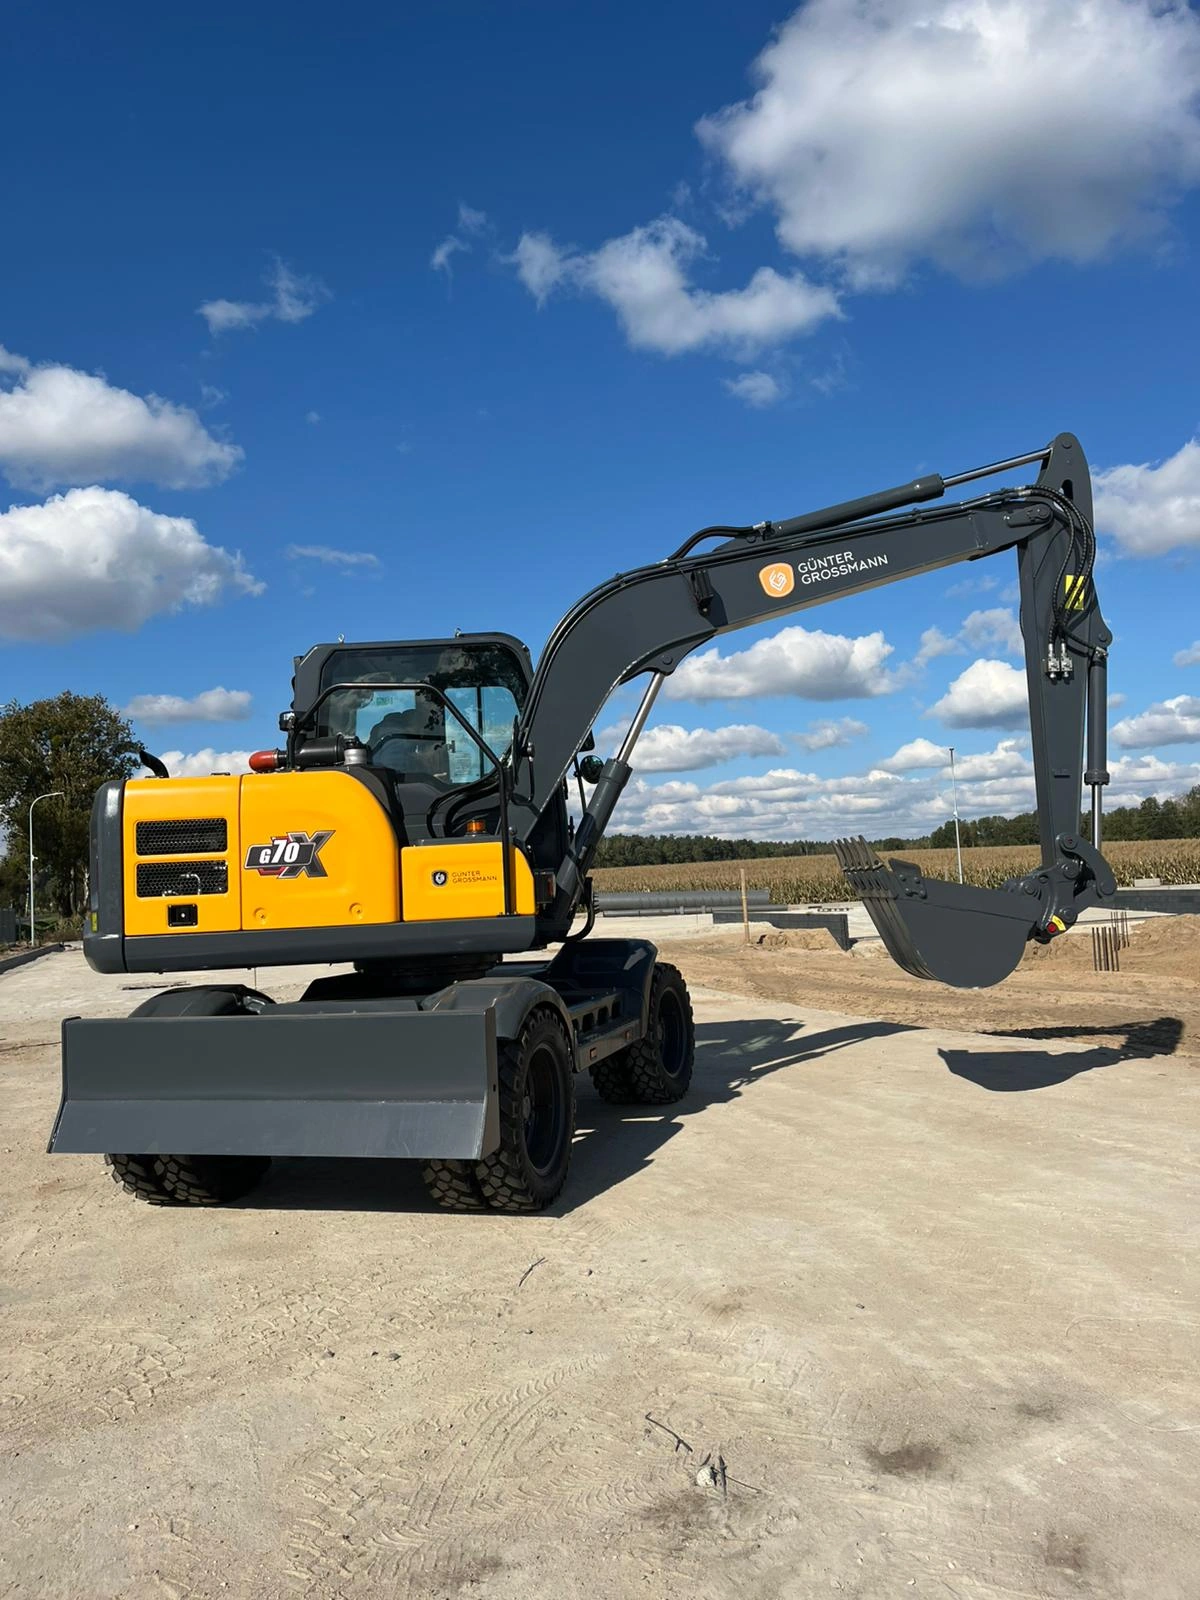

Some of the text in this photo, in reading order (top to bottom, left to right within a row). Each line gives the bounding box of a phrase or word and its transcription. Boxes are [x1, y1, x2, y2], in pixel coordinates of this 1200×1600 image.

[797, 551, 854, 573] GÜNTER
[801, 554, 889, 585] GROSSMANN
[452, 875, 497, 884] GROSSMANN
